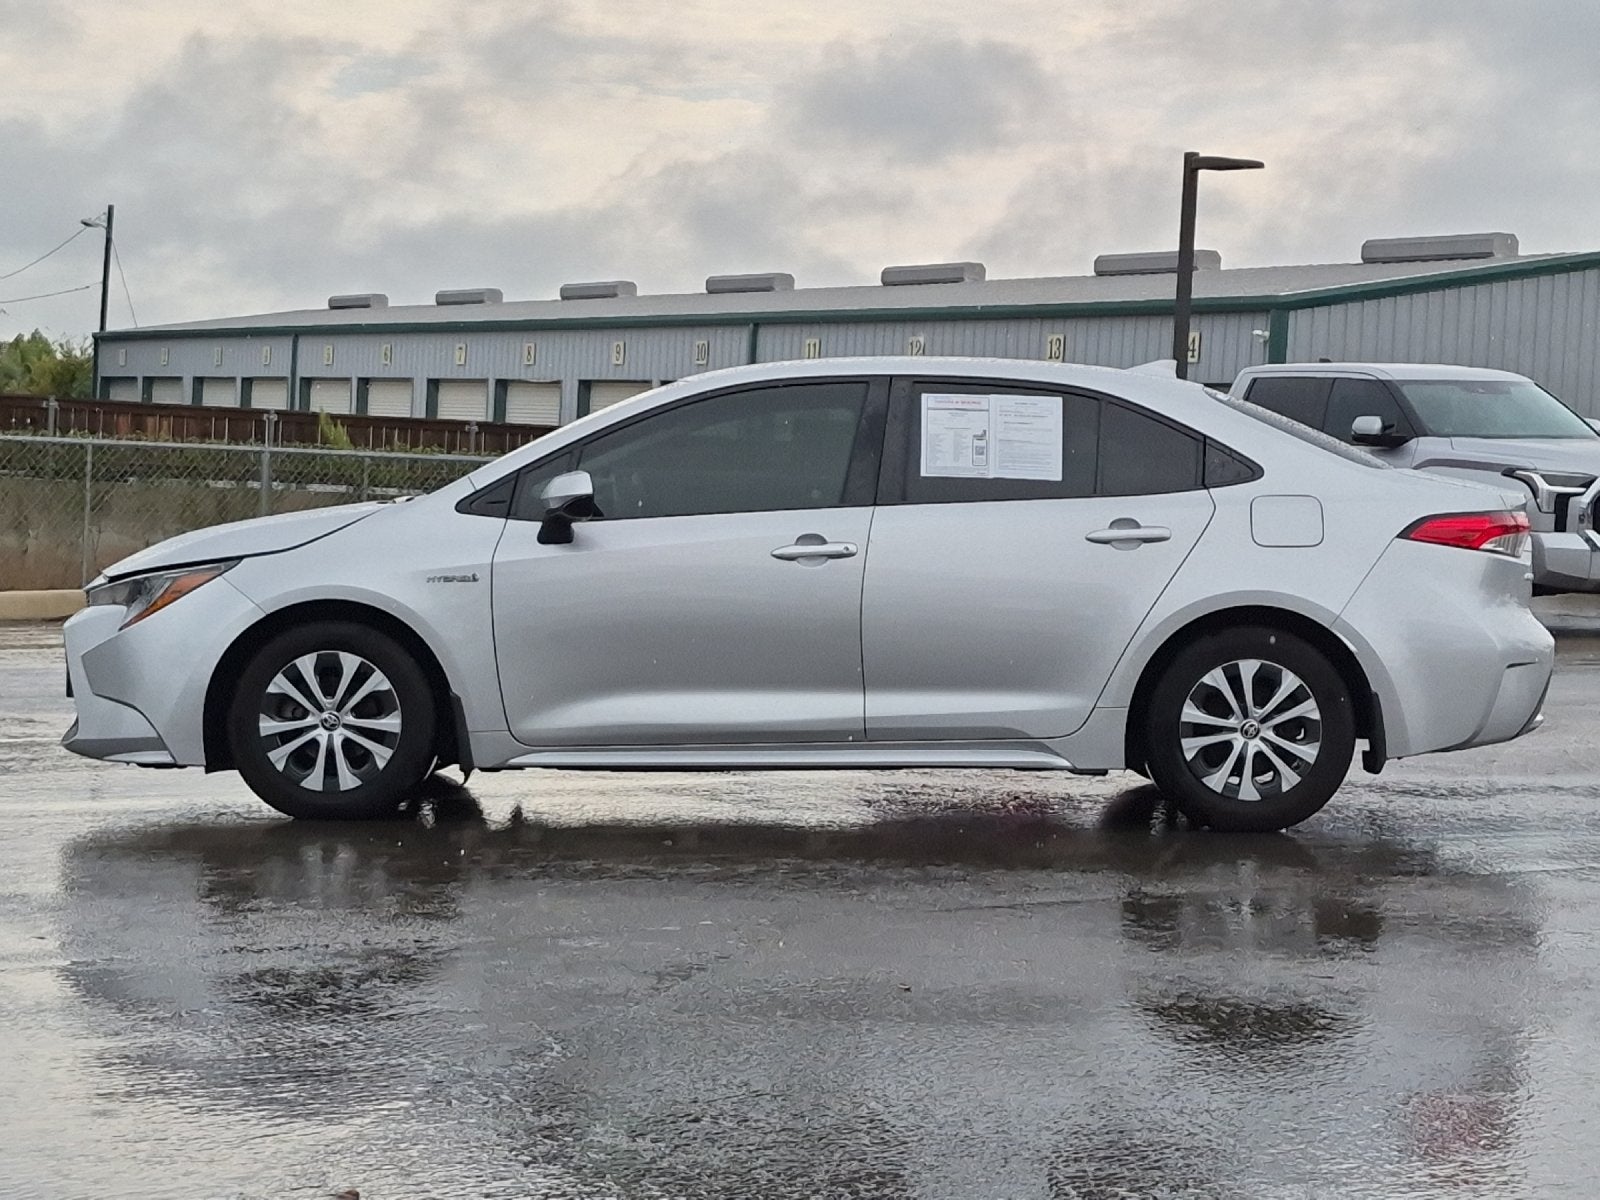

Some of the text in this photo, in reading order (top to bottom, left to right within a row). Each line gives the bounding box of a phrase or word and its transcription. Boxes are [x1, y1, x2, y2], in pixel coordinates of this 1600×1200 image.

[457, 346, 463, 362] 7
[526, 345, 532, 362] 8
[615, 343, 621, 362] 9
[695, 342, 706, 362] 10
[1047, 337, 1062, 360] 13
